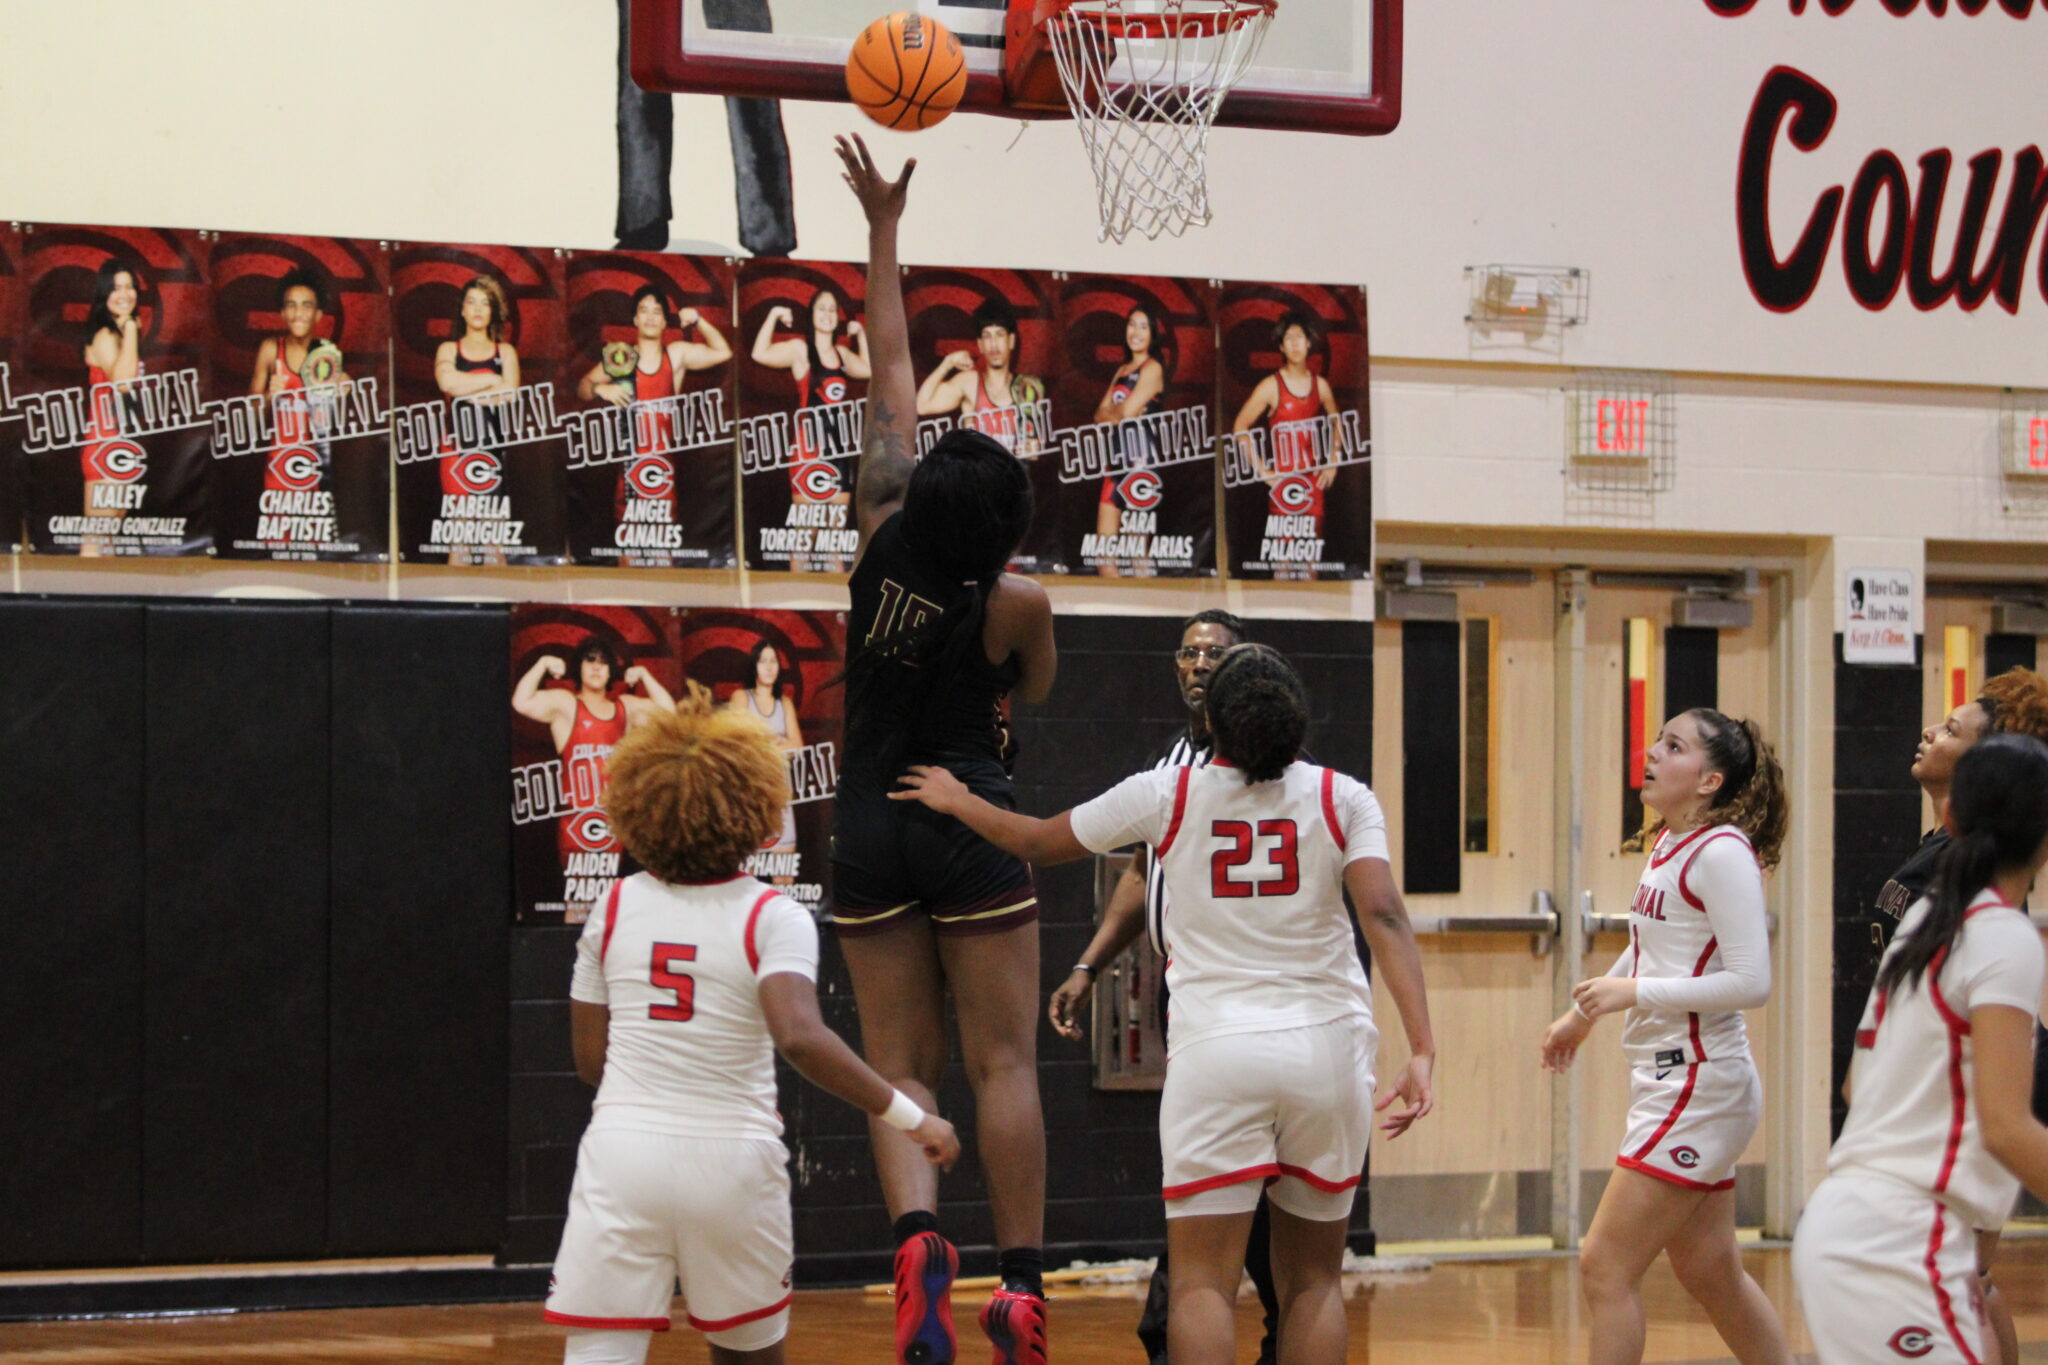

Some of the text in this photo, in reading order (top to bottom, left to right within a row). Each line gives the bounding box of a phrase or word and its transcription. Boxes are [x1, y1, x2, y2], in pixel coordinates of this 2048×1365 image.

[22, 368, 212, 453] COLONIAL
[210, 377, 391, 460] COLONIAL
[392, 382, 566, 464] COLONIAL
[566, 388, 735, 469] COLONIAL
[1597, 399, 1649, 452] EXIT
[1058, 405, 1216, 483] COLONIAL
[1222, 410, 1372, 487] COLONIAL
[2029, 418, 2048, 469] E
[92, 484, 148, 510] KALEY
[259, 490, 332, 516] CHARLES
[441, 495, 511, 520] ISABELLA
[623, 499, 673, 524] ANGEL
[785, 503, 848, 528] ARIELYS
[1119, 511, 1157, 534] SARA
[49, 515, 187, 535] CANTARERO GONZALEZ
[256, 515, 333, 541] BAPTISTE
[431, 521, 524, 546] RODRIGUEZ
[614, 524, 683, 548] CANALES
[1265, 515, 1316, 538] MIGUEL
[760, 528, 813, 552] TORRES
[1080, 534, 1194, 559] MAGANA ARIAS
[1259, 538, 1325, 561] PALAGOT
[564, 853, 620, 876] JAIDEN
[738, 853, 801, 877] PHANIE
[1210, 818, 1300, 898] 23
[648, 941, 698, 1022] 5
